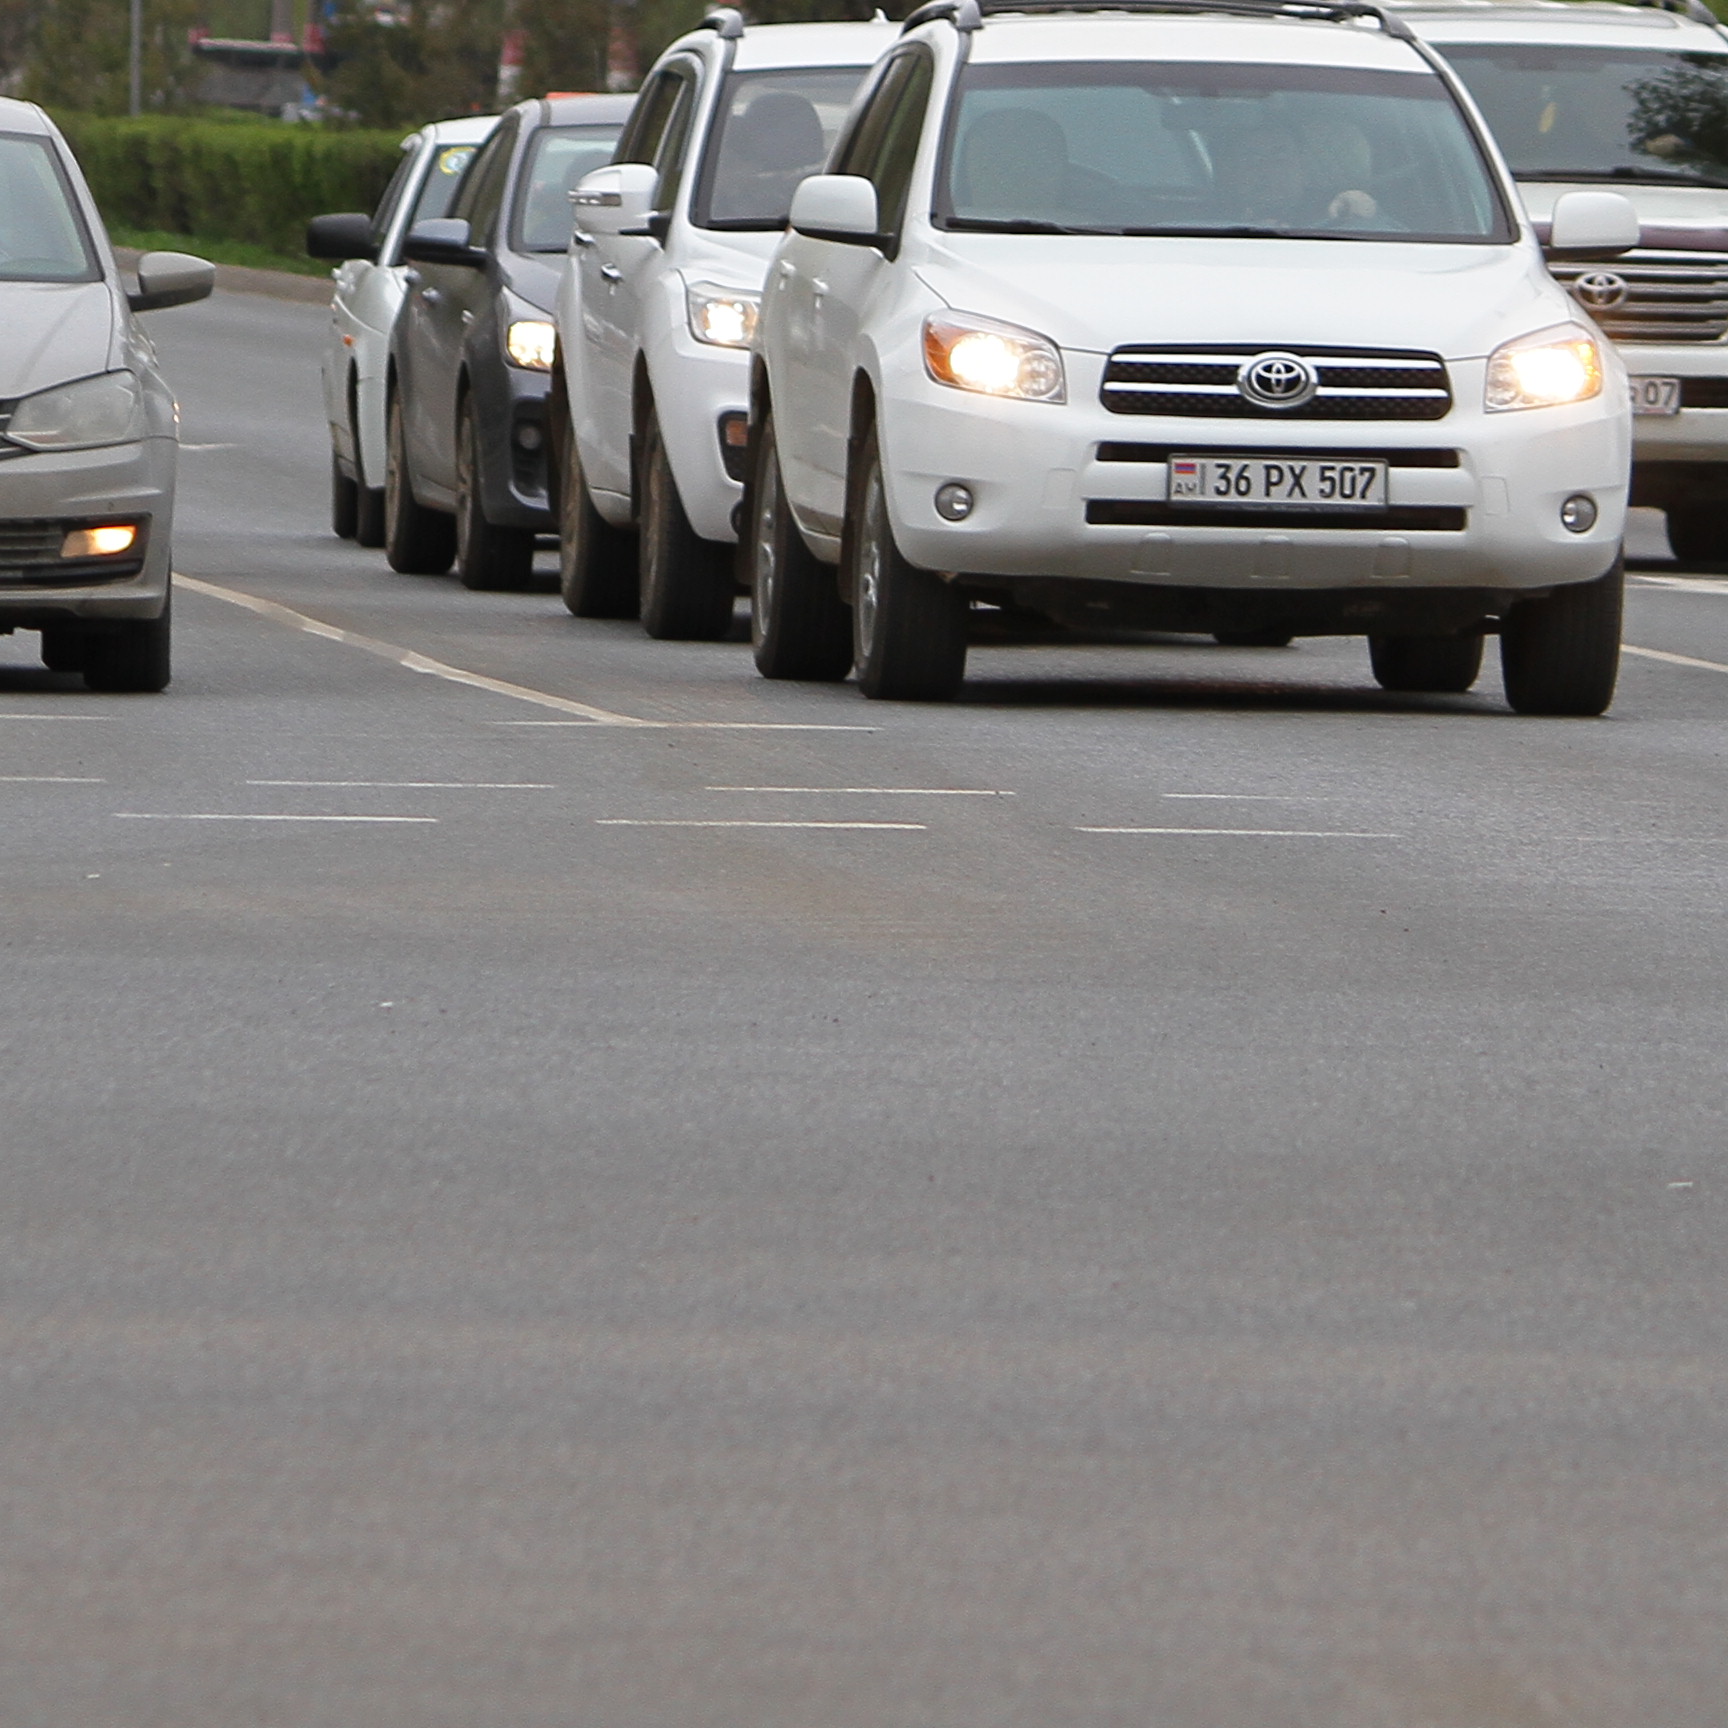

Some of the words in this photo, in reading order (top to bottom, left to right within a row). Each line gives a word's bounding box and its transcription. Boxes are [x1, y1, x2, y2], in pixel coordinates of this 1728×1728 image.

[1646, 380, 1677, 405] 07
[1214, 463, 1252, 497] 36
[1263, 464, 1308, 498] PX
[1318, 465, 1377, 500] 507
